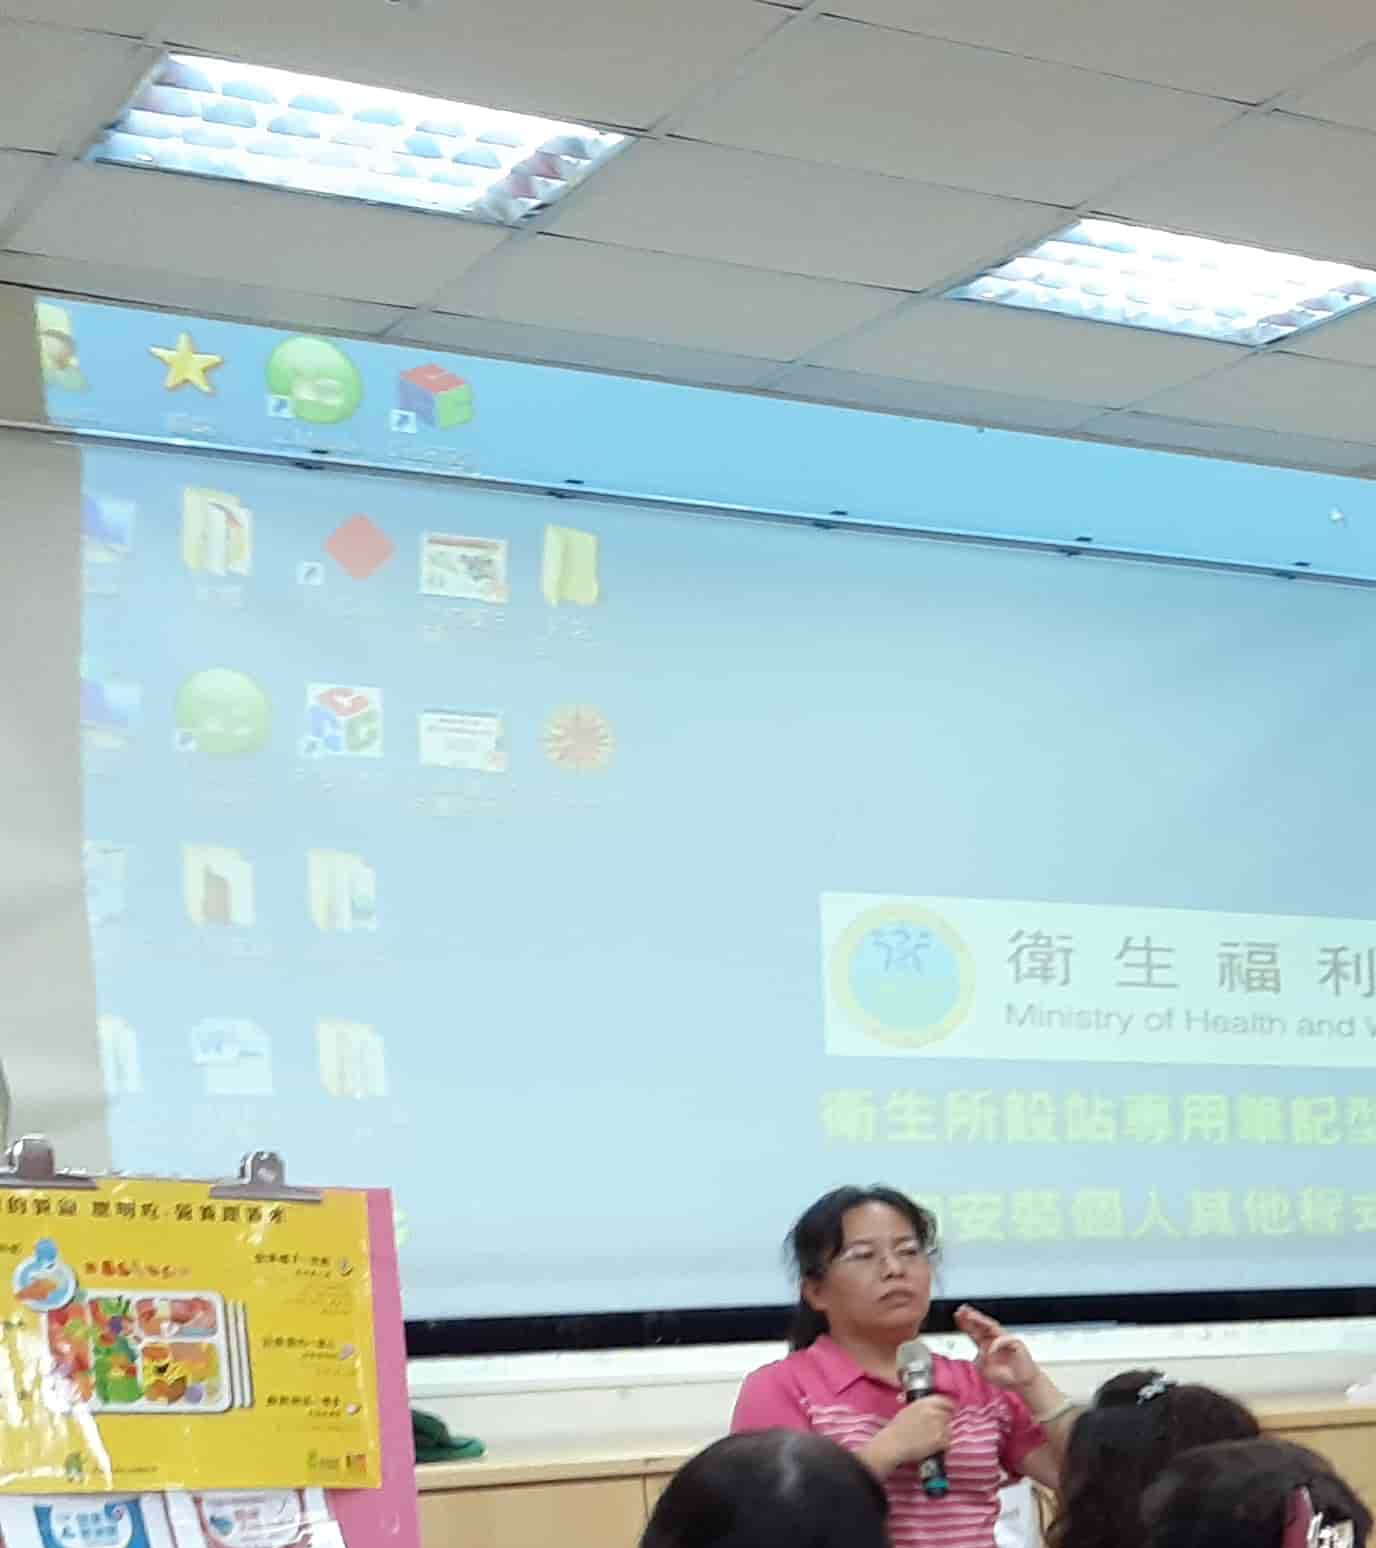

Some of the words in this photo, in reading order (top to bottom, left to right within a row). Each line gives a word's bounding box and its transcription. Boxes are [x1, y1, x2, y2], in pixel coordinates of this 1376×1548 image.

[1008, 929, 1376, 998] 衛生福利
[1007, 1002, 1135, 1036] Ministry
[1143, 1006, 1175, 1033] of
[1184, 1009, 1287, 1035] Health
[1296, 1013, 1355, 1039] and
